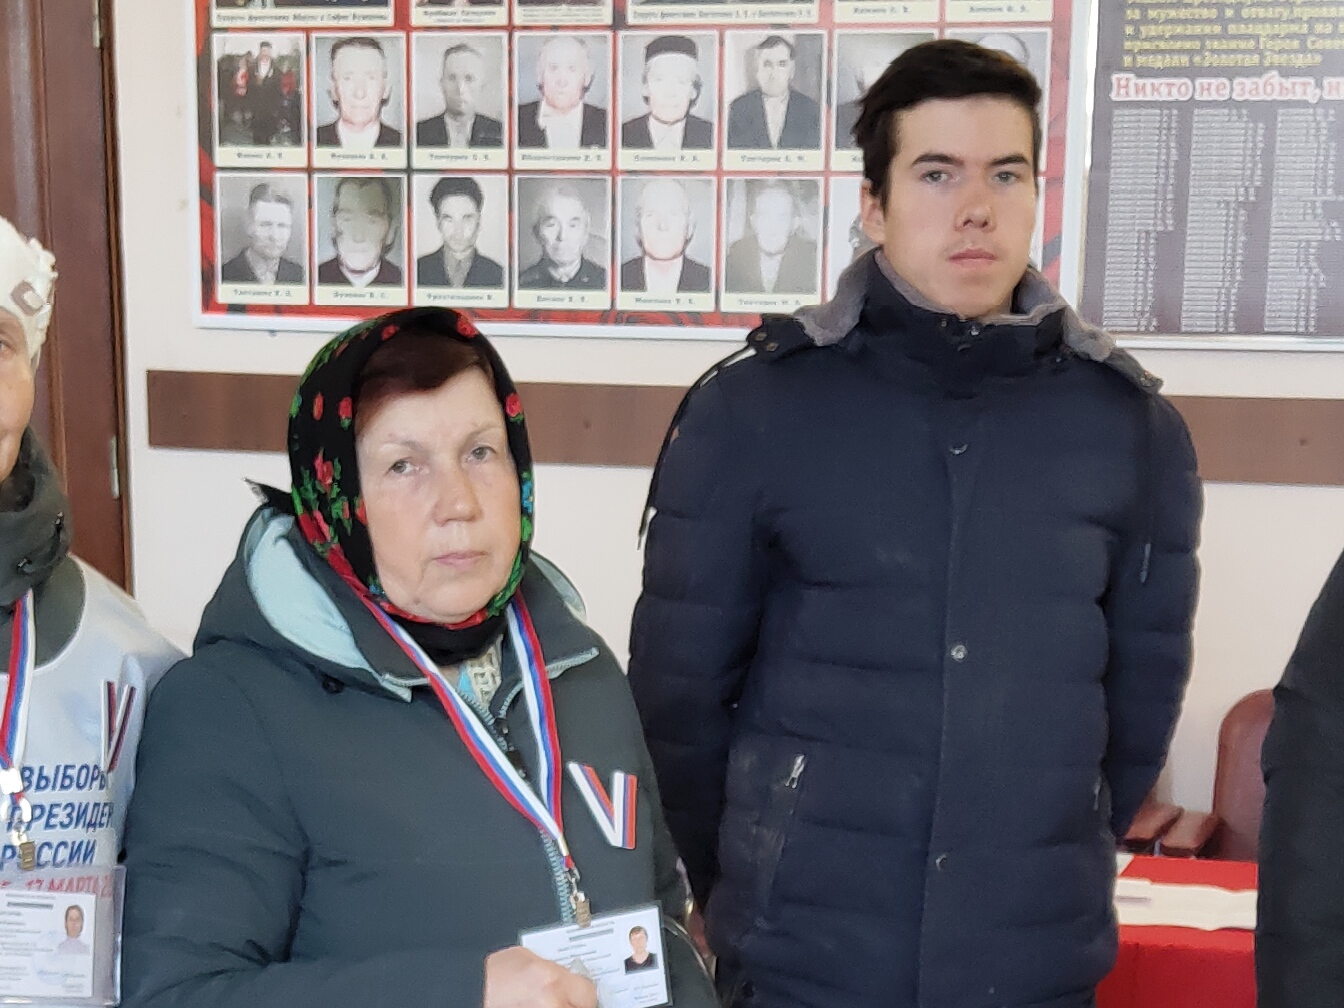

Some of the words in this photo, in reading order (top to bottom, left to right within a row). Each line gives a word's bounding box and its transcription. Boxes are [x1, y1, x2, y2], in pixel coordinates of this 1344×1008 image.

[1113, 76, 1191, 99] Никто
[1197, 81, 1230, 98] не
[1232, 71, 1321, 102] забыт,
